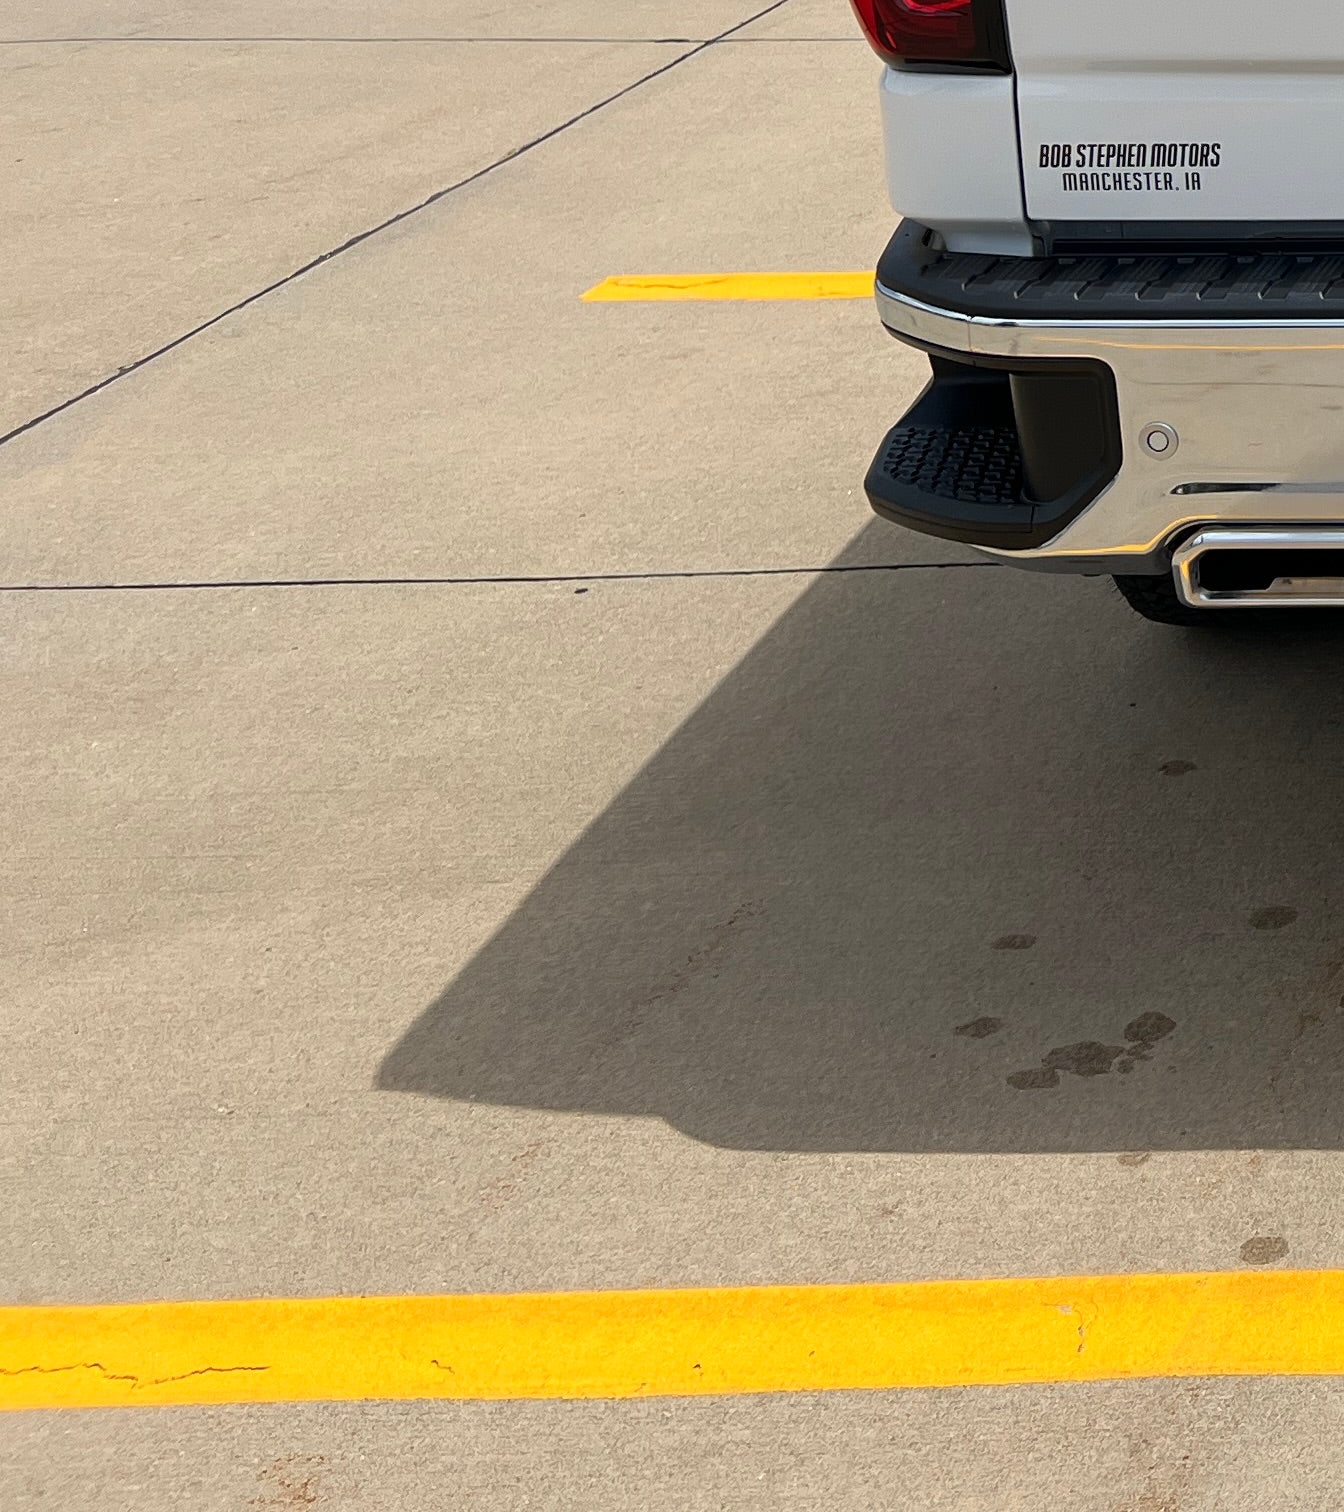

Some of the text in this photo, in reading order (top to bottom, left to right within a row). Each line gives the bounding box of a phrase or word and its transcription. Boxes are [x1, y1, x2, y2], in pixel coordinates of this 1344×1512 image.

[1039, 142, 1221, 168] BOB STEPHEN MOTORS
[1185, 172, 1201, 191] IA
